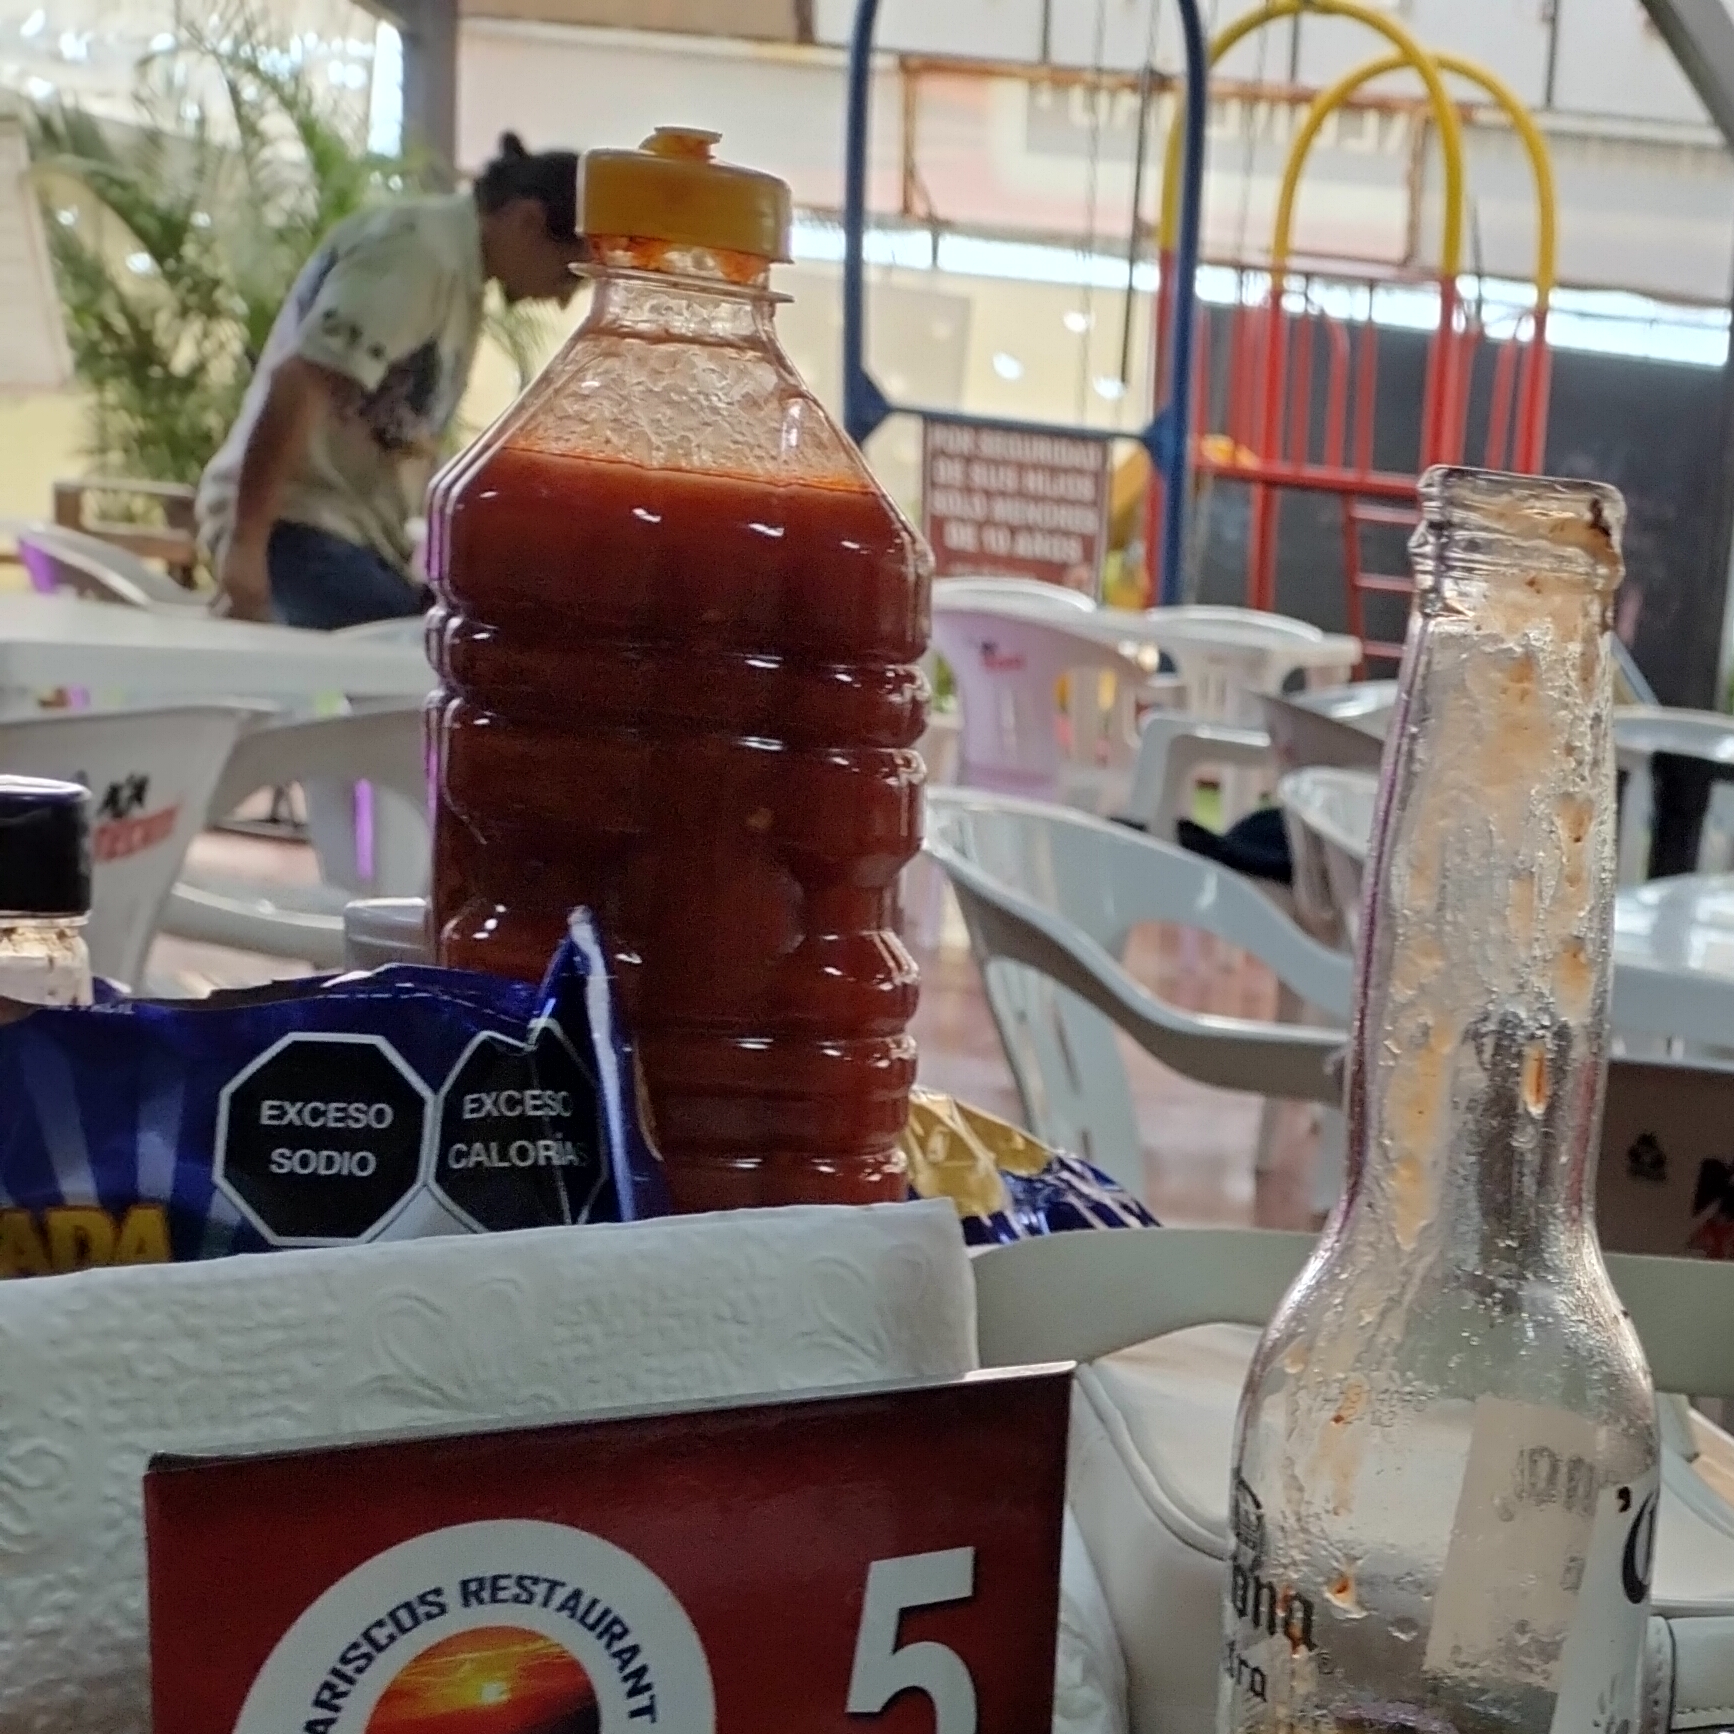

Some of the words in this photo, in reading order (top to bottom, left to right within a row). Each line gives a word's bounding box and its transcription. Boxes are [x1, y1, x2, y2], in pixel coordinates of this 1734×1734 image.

[259, 1100, 394, 1130] EXCESO
[270, 1148, 377, 1177] SODIO
[460, 1573, 658, 1724] RESTAURANT
